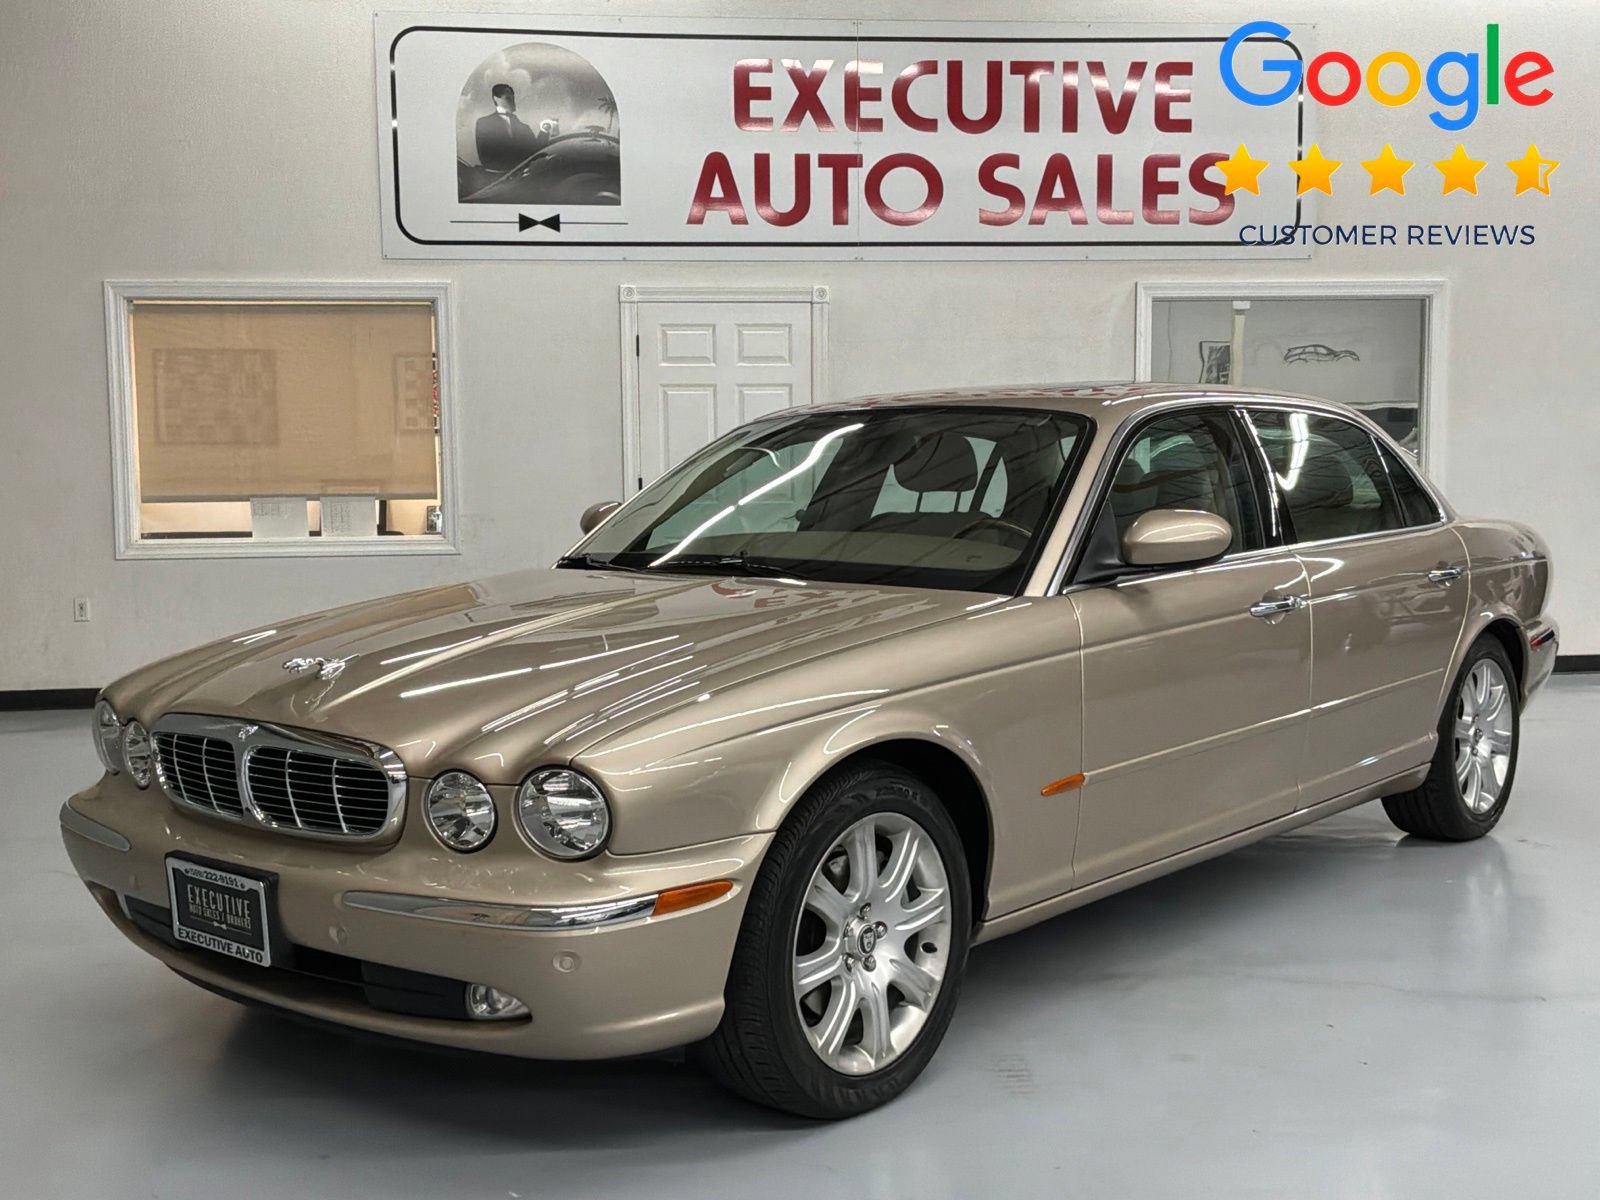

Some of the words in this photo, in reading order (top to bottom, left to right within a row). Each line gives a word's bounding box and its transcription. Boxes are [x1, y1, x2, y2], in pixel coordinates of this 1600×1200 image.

[733, 58, 1194, 134] EXECUTIVE
[686, 151, 945, 227] AUTO
[978, 151, 1236, 226] SALES
[187, 884, 251, 919] EXECUTIVE
[178, 927, 234, 954] EXECUTIVE
[235, 945, 264, 964] AUTO
